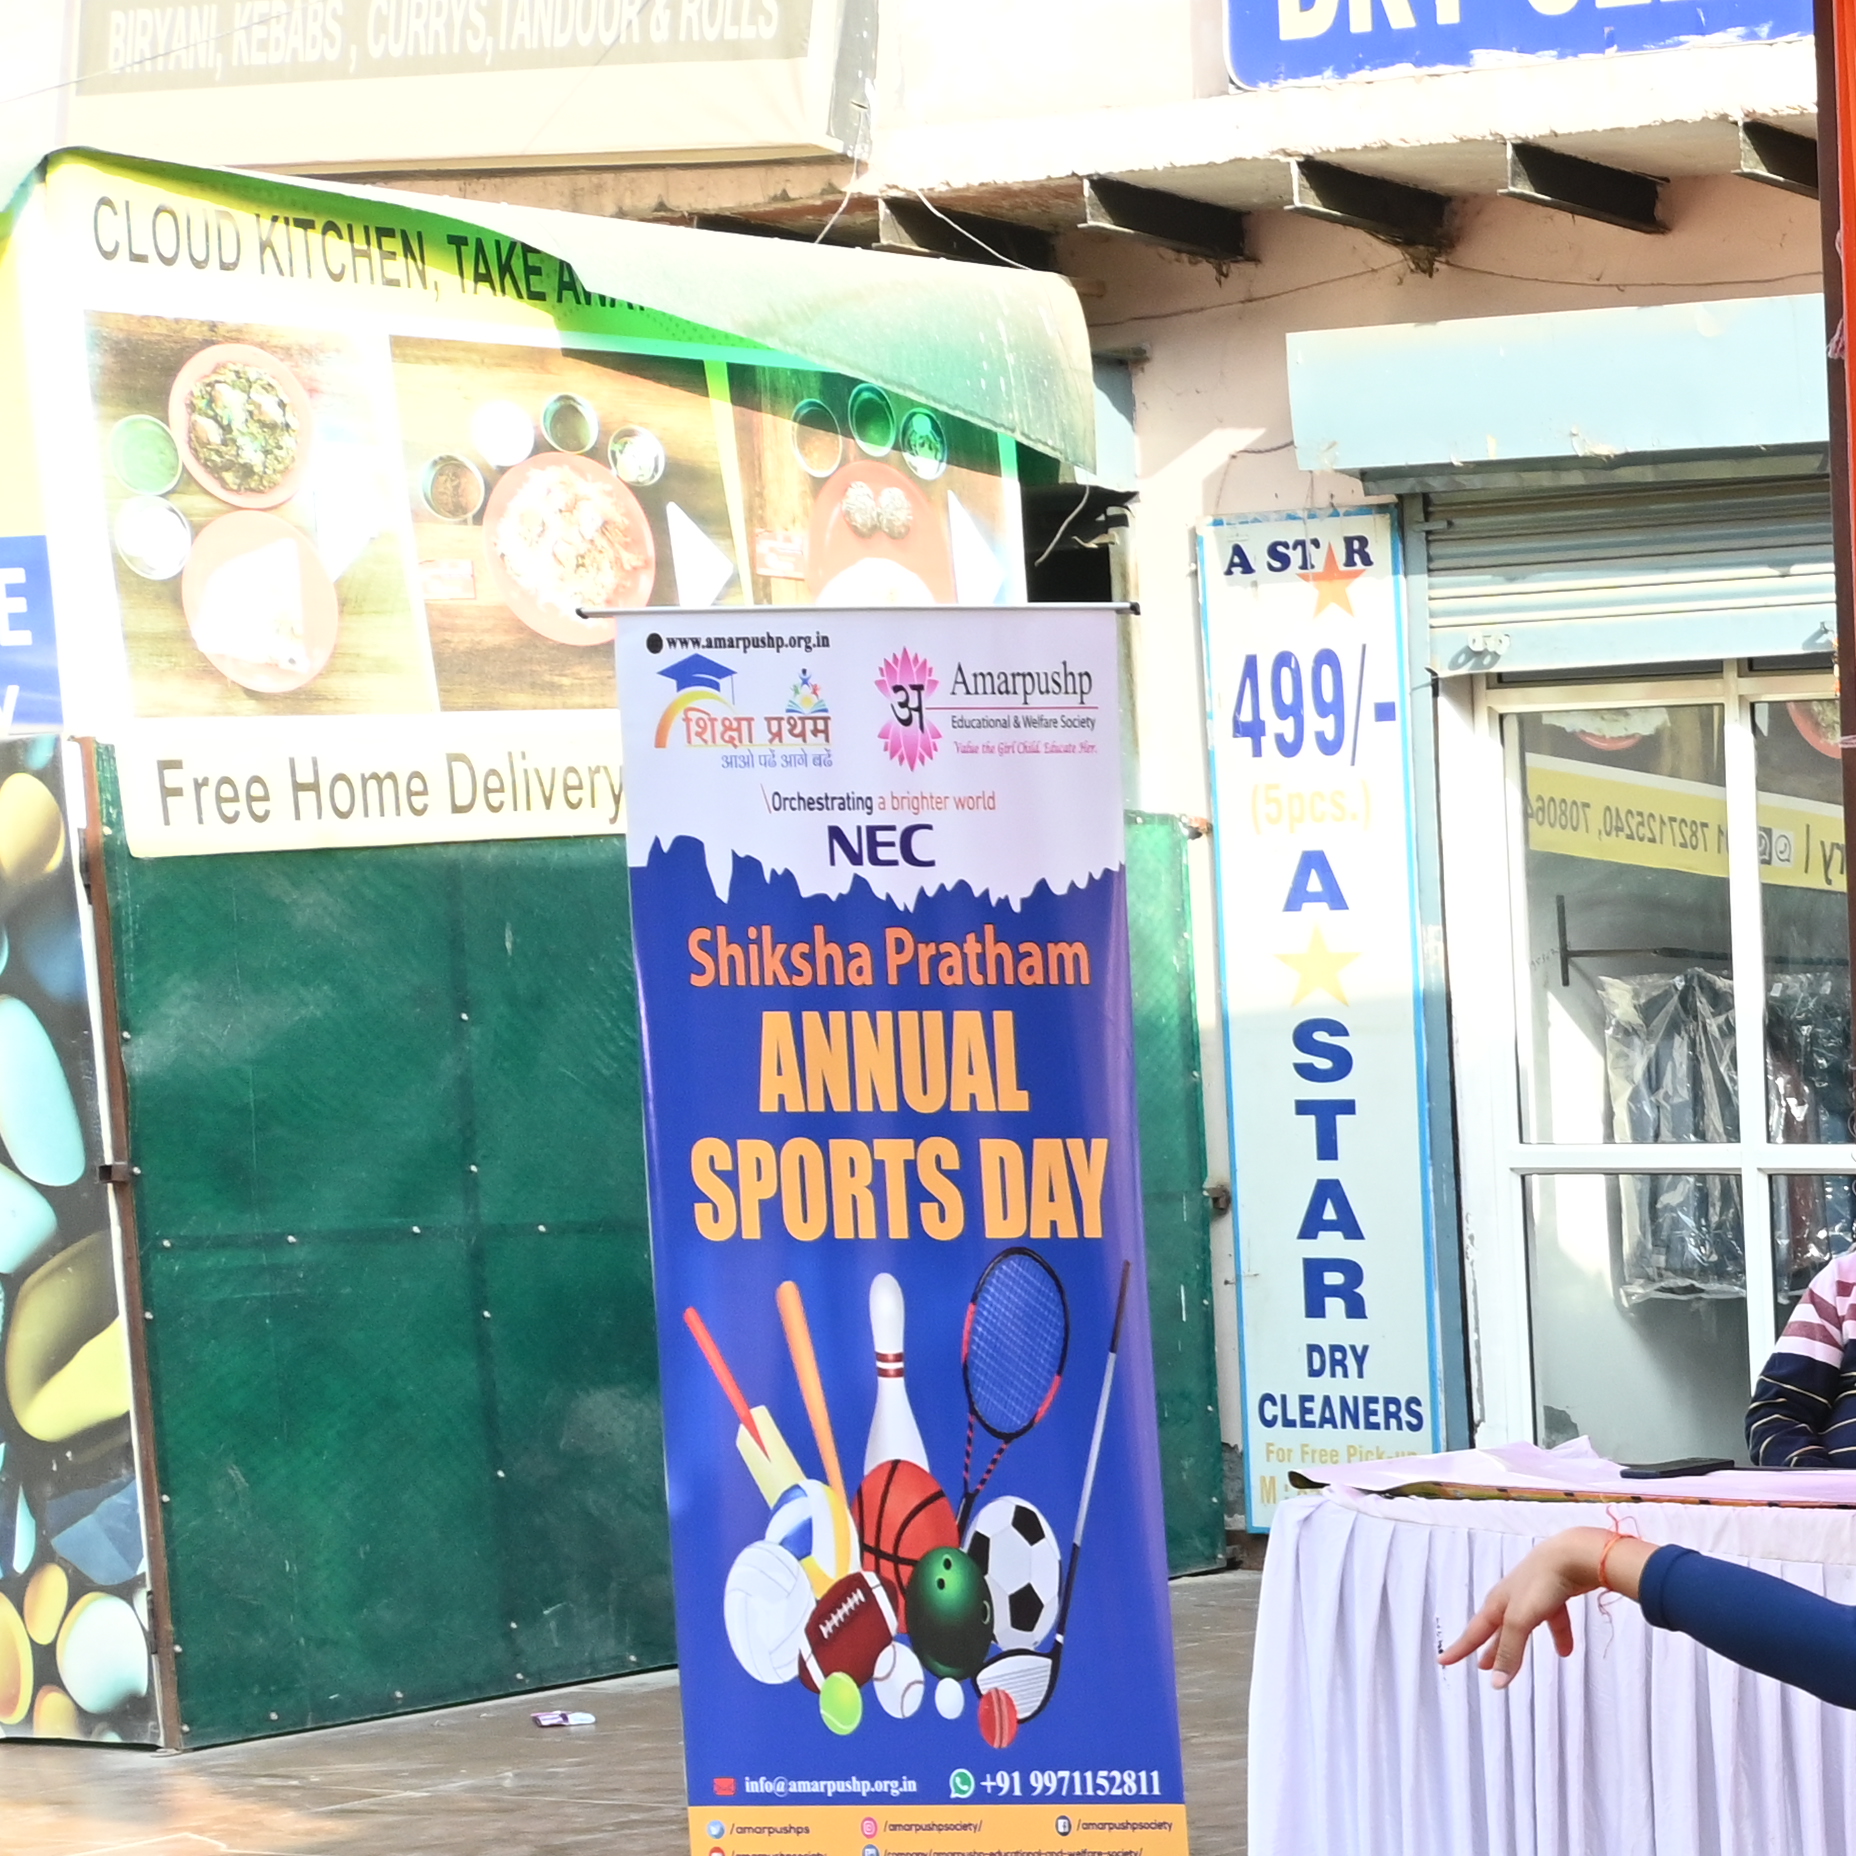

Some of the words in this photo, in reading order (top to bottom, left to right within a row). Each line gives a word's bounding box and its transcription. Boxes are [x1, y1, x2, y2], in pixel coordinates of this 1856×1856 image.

[108, 5, 223, 81] BIRYANI,
[367, 0, 493, 66] CURRYS,
[93, 195, 242, 272] CLOUD
[255, 212, 440, 302] KITCHEN,
[447, 233, 547, 301] TAKE
[1224, 543, 1255, 577] A
[666, 630, 831, 653] www.amarpushp.org.in
[950, 660, 1093, 705] Amarpushp
[951, 715, 1010, 730] Educational
[1013, 715, 1021, 729] &
[1022, 714, 1059, 729] Welfare
[1061, 714, 1097, 731] Society
[1232, 644, 1397, 767] 499/-
[682, 706, 755, 749] शिक्षा
[764, 715, 832, 745] प्रथम
[156, 758, 271, 827] Free
[289, 754, 430, 823] Home
[447, 750, 625, 826] Delivery
[877, 796, 887, 811] a
[890, 790, 950, 815] brighter
[953, 790, 997, 811] world
[1250, 778, 1372, 836] (5pcs.)
[826, 822, 937, 869] NEC
[687, 924, 874, 989] Shiksha
[886, 923, 1092, 988] Pratham
[758, 1009, 1030, 1115] ANNUAL
[690, 1135, 962, 1242] SPORTS
[980, 1136, 1110, 1240] DAY
[1306, 1343, 1370, 1379] DRY
[1258, 1392, 1425, 1433] CLEANERS
[1266, 1442, 1294, 1464] For
[1301, 1443, 1340, 1465] Free
[744, 1775, 918, 1798] info@amarpushp.org.in
[980, 1770, 1022, 1797] +91
[1030, 1769, 1162, 1797] 9971152811
[730, 1822, 811, 1837] /amarpushps
[884, 1819, 983, 1834] /amarpushpsociety/
[1077, 1818, 1173, 1833] /amarpushpsociety
